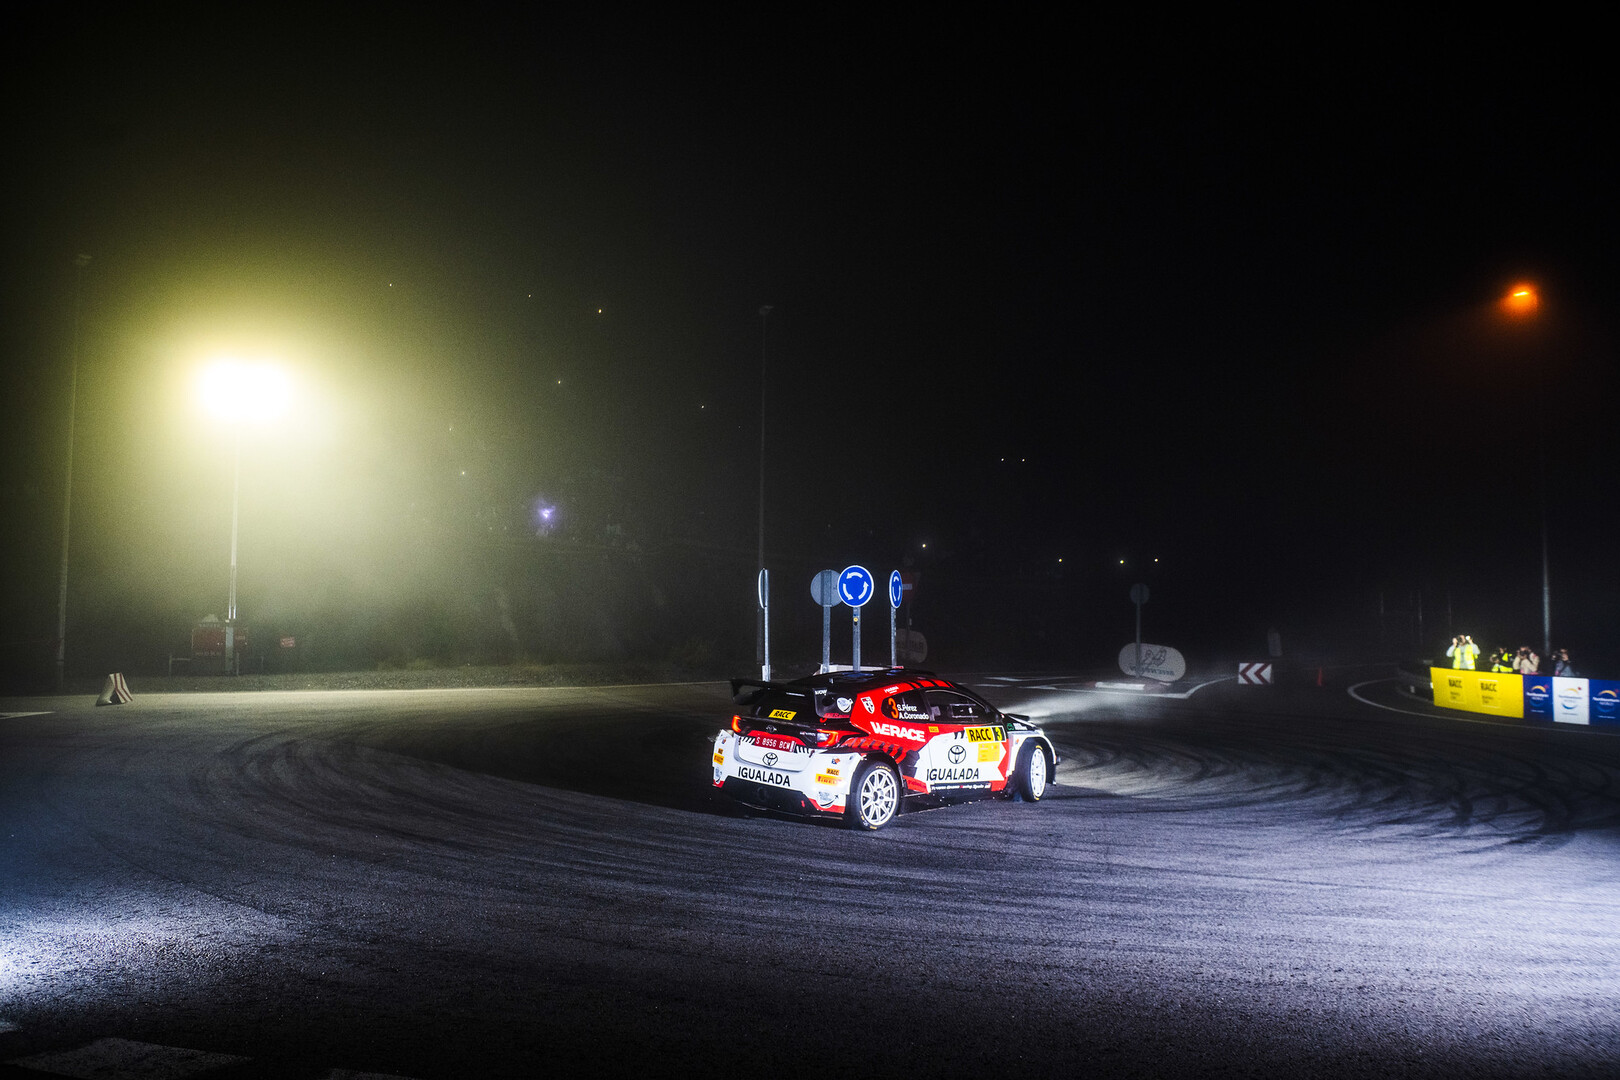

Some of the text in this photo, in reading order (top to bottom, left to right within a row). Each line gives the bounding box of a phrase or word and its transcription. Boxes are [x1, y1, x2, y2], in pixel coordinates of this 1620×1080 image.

[773, 710, 792, 719] RACC
[888, 697, 898, 719] 3
[969, 728, 992, 741] RACC
[995, 727, 1003, 741] 3
[738, 766, 791, 787] IGUALADA
[926, 768, 979, 781] IGUALADA
